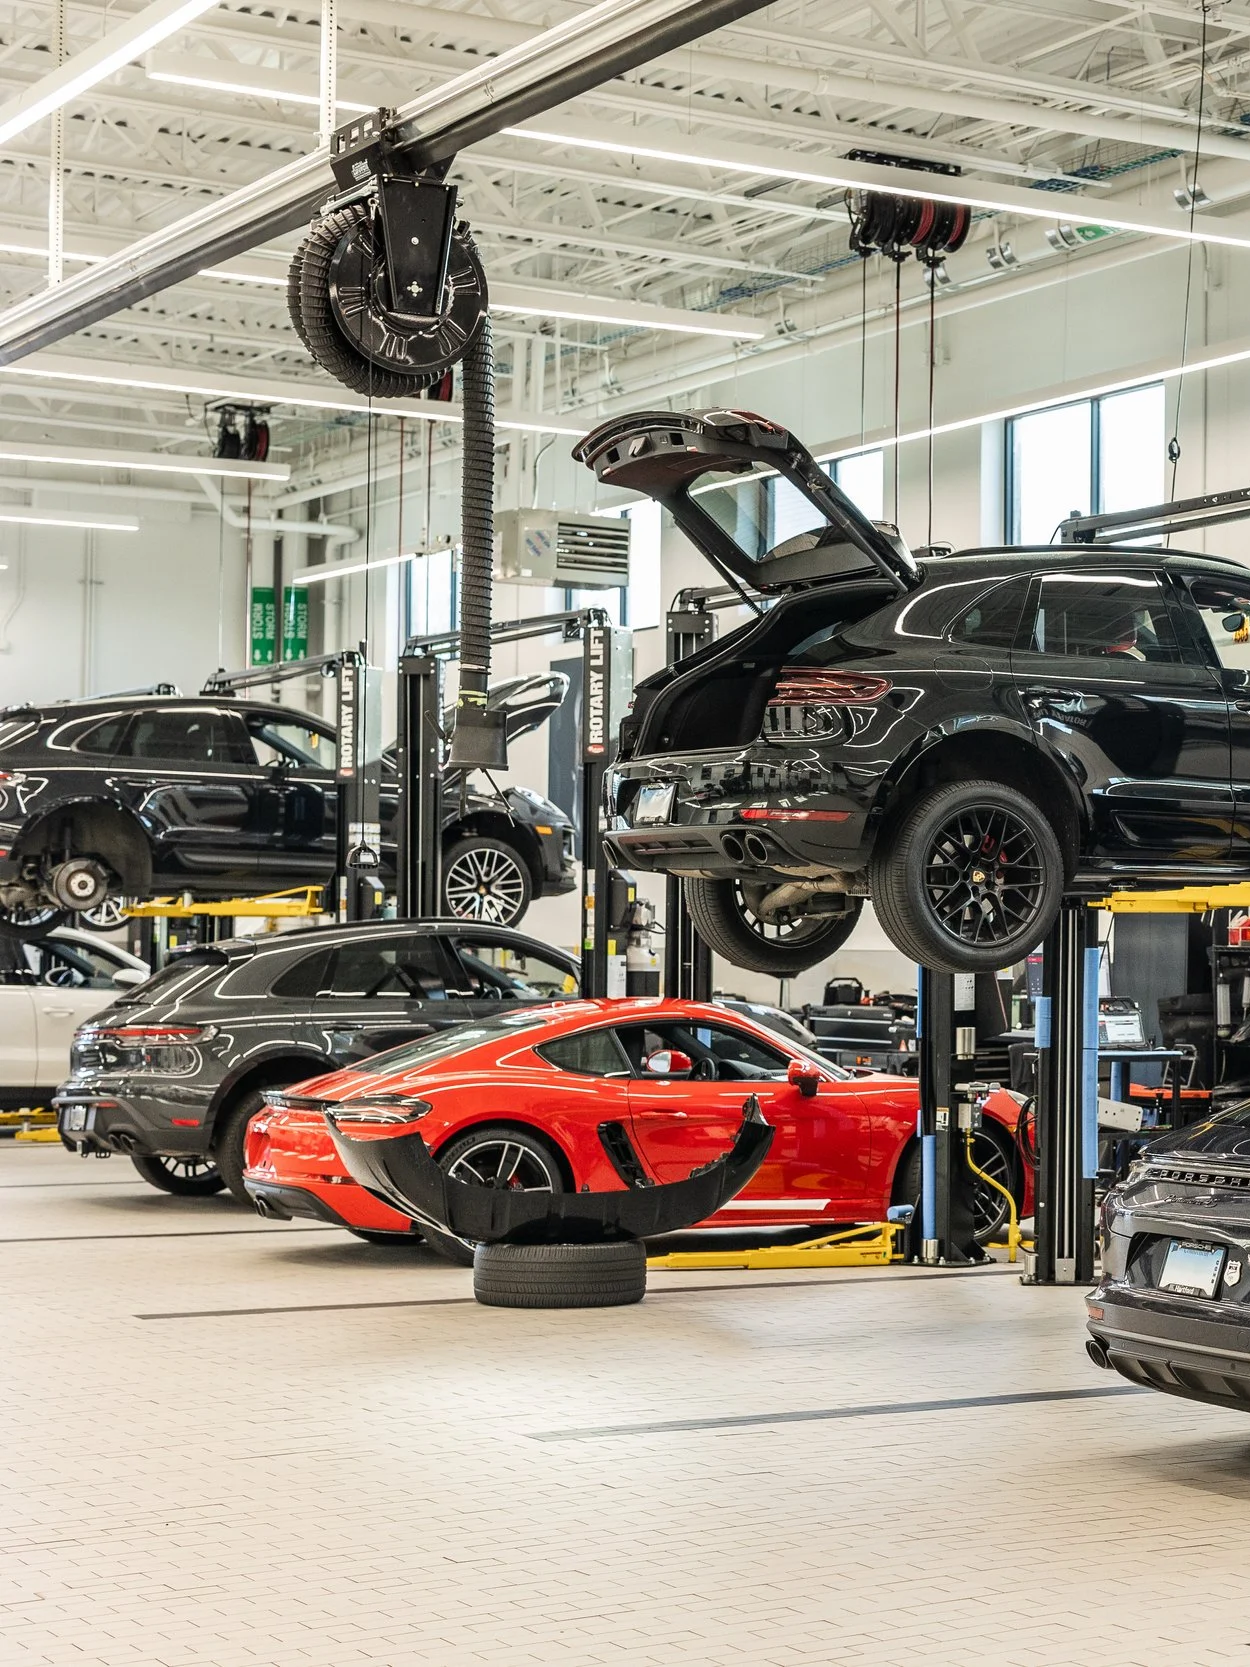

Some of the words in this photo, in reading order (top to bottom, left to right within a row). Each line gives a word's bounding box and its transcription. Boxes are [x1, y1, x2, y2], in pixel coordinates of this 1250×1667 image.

[252, 603, 264, 639] STORM
[265, 603, 275, 639] STORM
[297, 603, 307, 639] STORM
[590, 628, 604, 666] LIFT
[341, 667, 353, 701] LIFT
[590, 671, 604, 744] ROTARY
[341, 704, 353, 768] ROTARY
